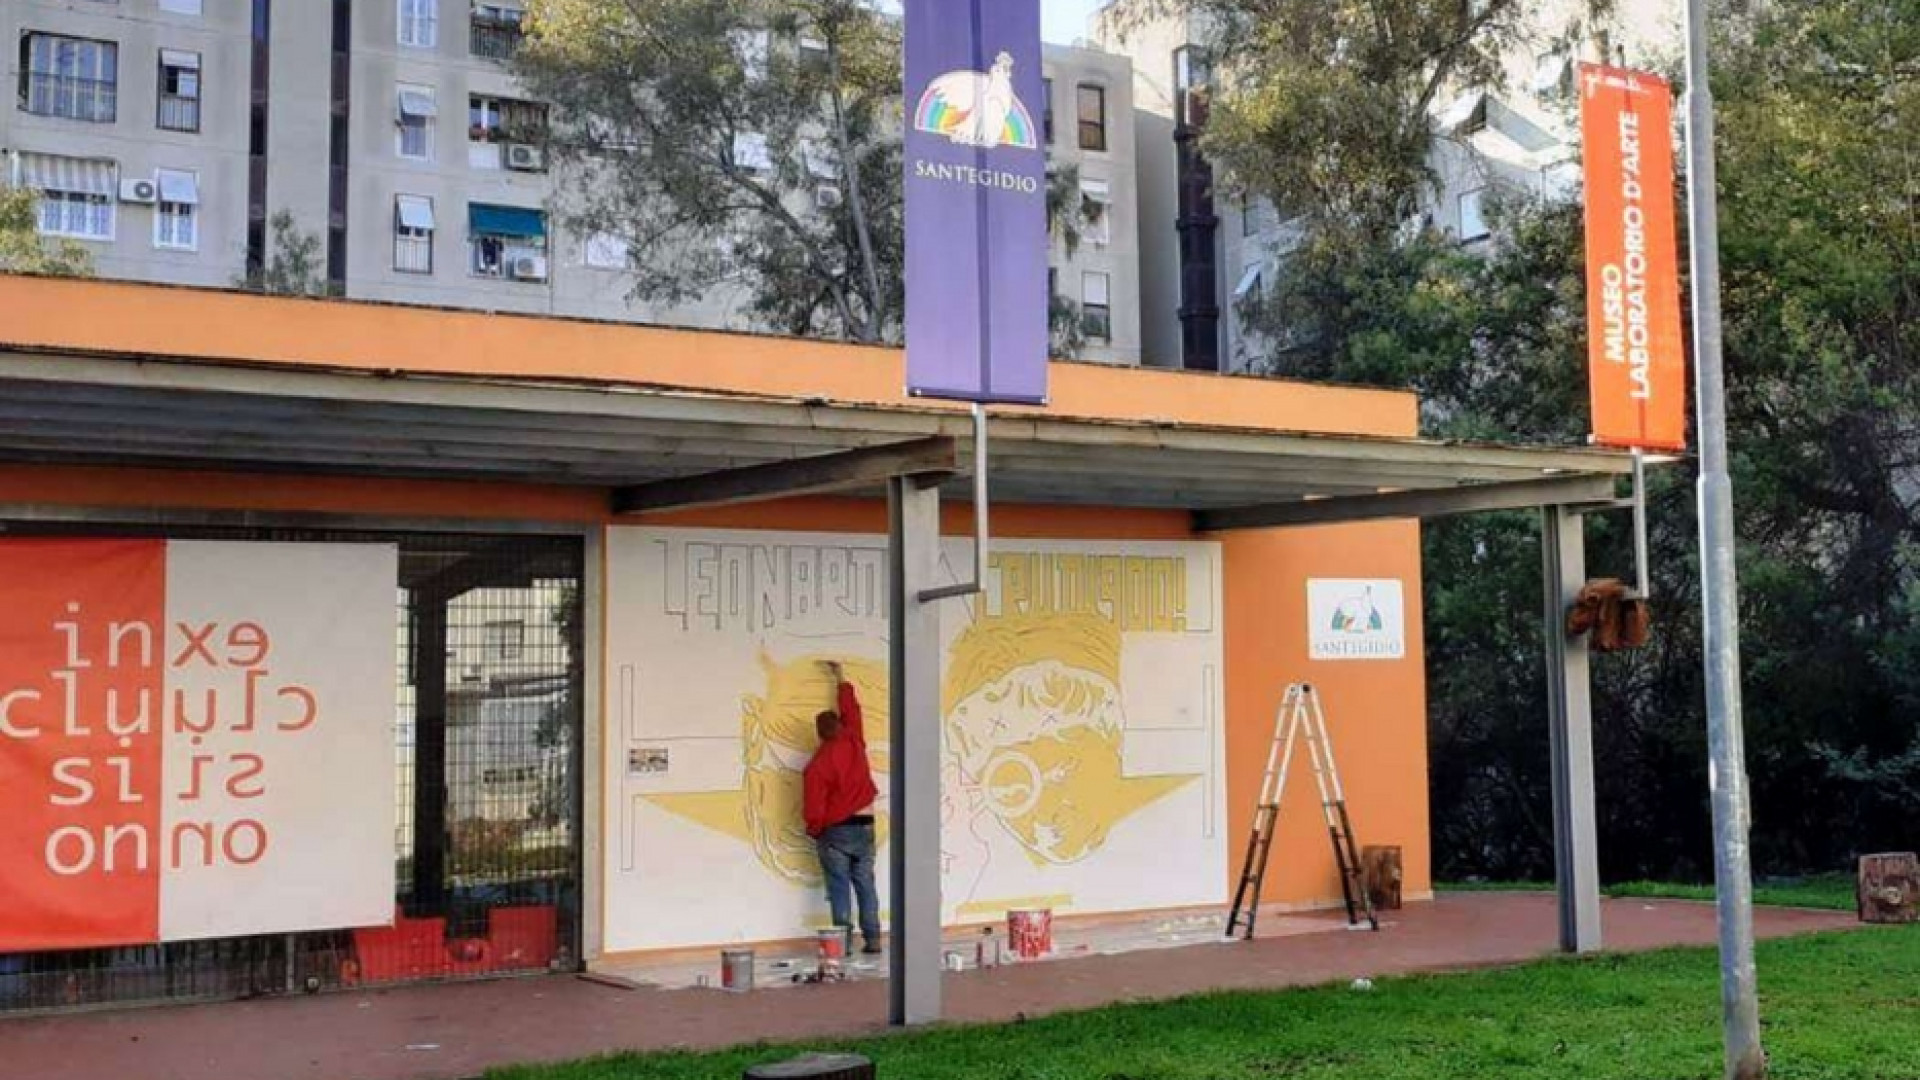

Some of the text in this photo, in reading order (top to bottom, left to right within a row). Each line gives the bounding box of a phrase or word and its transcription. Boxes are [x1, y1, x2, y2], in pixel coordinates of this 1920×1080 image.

[1619, 110, 1650, 398] LABORATORIO D'ARTE
[1602, 263, 1624, 363] MUSEO
[653, 540, 889, 631] LEONARD
[53, 600, 152, 667] in
[0, 670, 151, 739] clu
[50, 736, 143, 806] si
[45, 822, 148, 875] on
